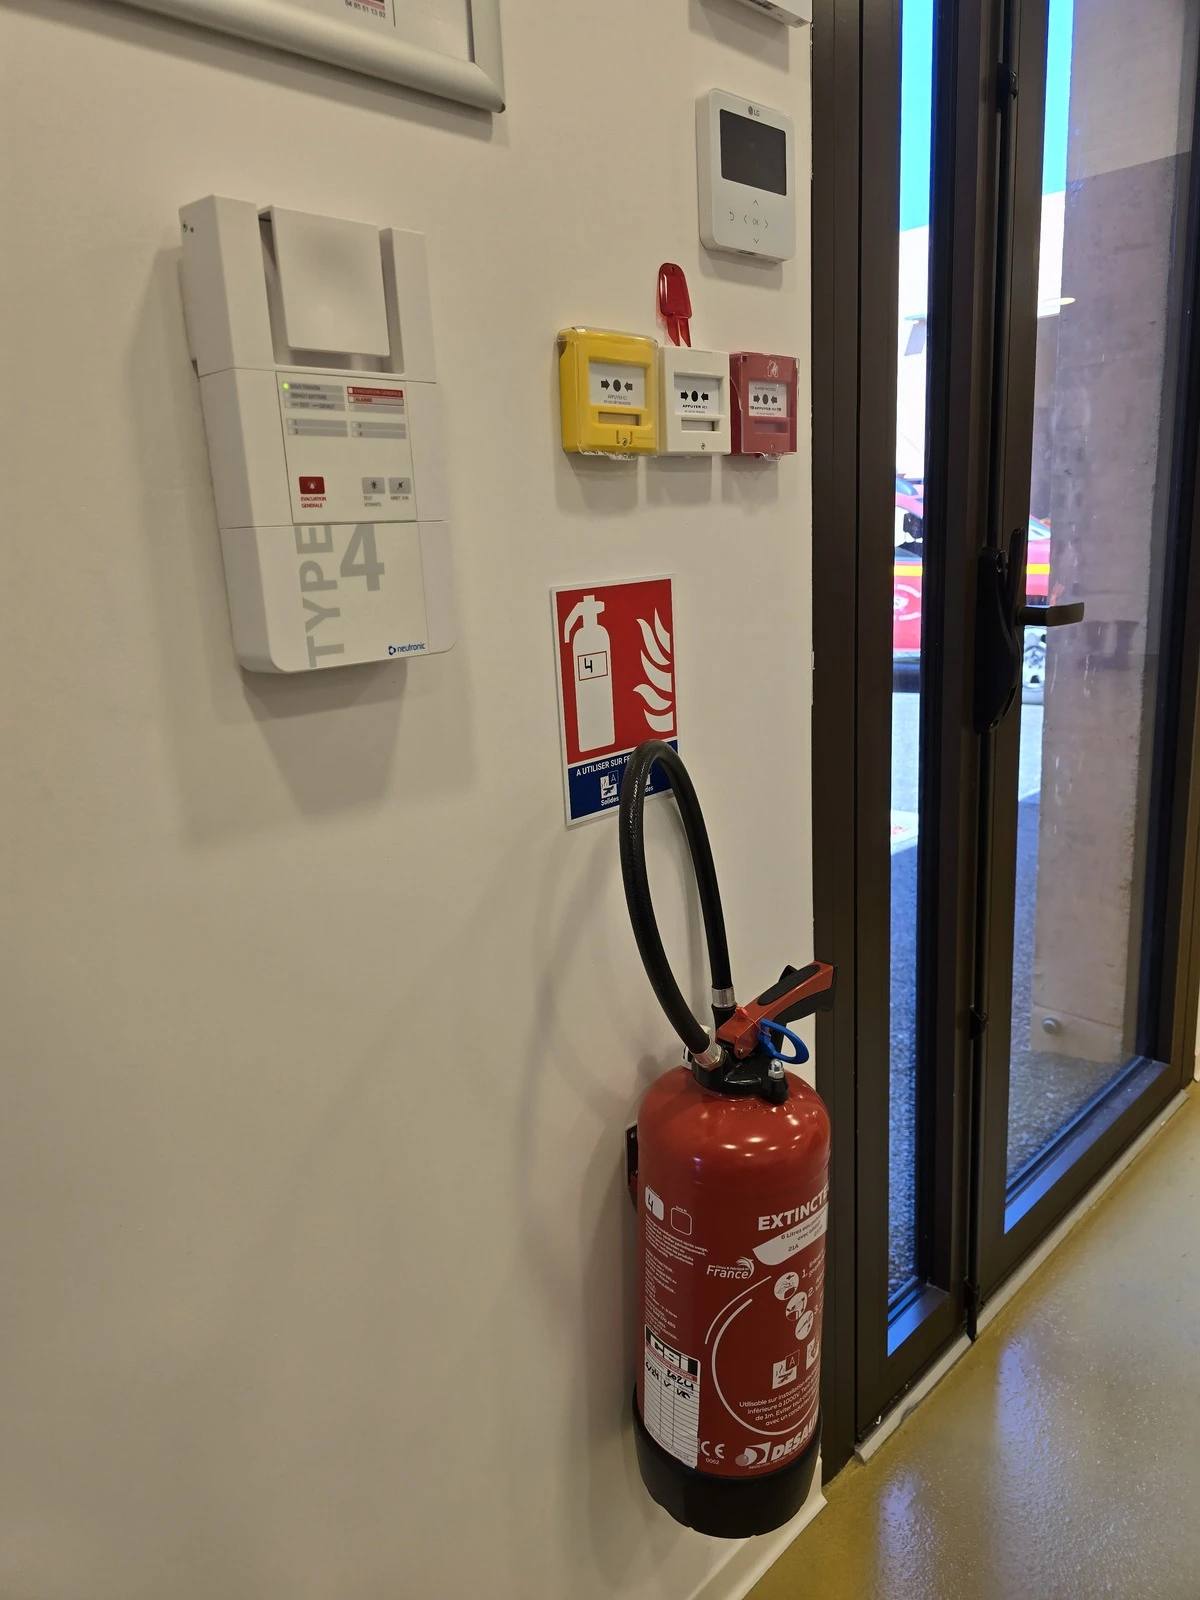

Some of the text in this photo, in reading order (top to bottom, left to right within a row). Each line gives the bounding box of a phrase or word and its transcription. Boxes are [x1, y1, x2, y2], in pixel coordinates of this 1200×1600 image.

[294, 523, 385, 669] TYPE 4
[397, 642, 426, 653] neutronic
[584, 657, 593, 673] 4
[576, 769, 582, 777] A
[582, 761, 610, 775] UTILISER
[610, 757, 623, 767] SUR
[610, 774, 617, 782] A
[601, 796, 619, 806] Solides
[758, 1182, 829, 1231] EXTINCTE
[786, 1226, 802, 1239] Litres
[788, 1243, 799, 1252] 21A
[706, 1264, 749, 1280] France
[788, 1356, 796, 1367] A
[739, 1399, 768, 1408] Utilisable
[768, 1396, 778, 1404] sur
[747, 1403, 778, 1415] inférieure
[775, 1404, 792, 1416] Eviter
[771, 1406, 819, 1461] DESAU
[700, 1440, 725, 1460] CE
